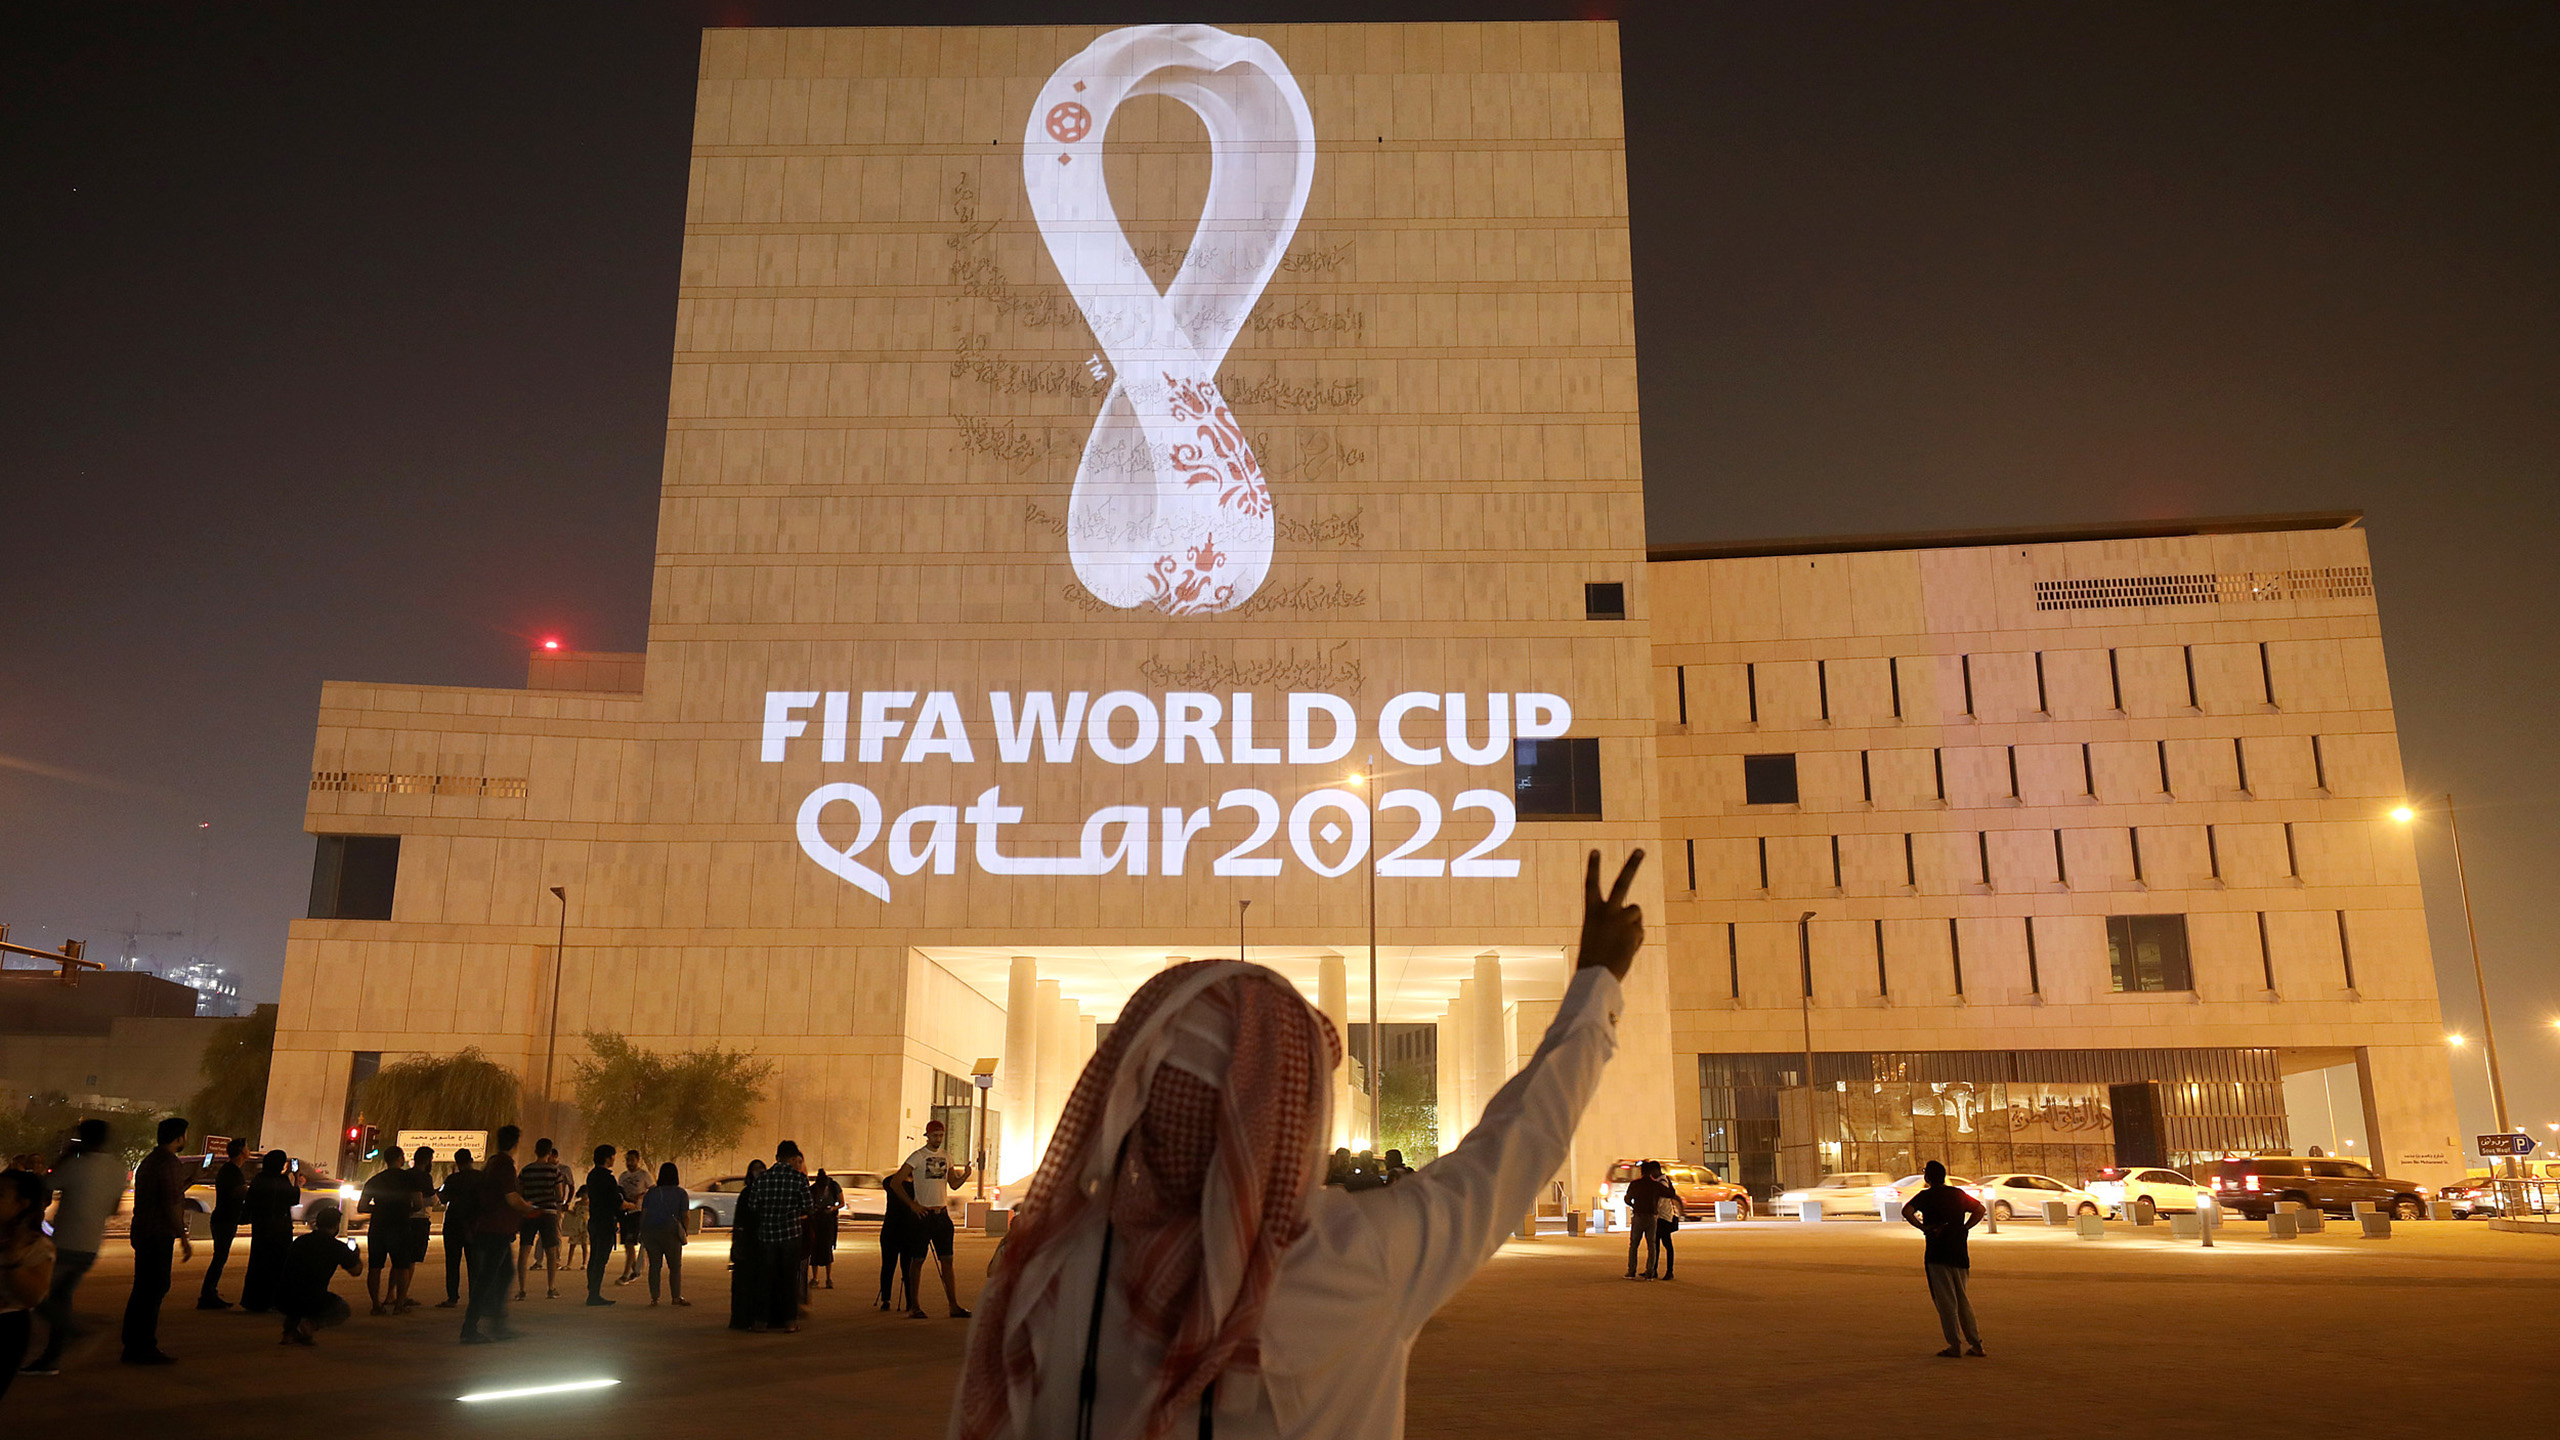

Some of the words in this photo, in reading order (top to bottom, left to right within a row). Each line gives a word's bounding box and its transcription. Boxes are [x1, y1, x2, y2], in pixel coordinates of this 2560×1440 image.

[1085, 351, 1101, 372] TM
[760, 690, 975, 763] FIFA
[990, 689, 1358, 765] WORLD
[1378, 691, 1572, 766] CUP
[2516, 1138, 2525, 1150] P
